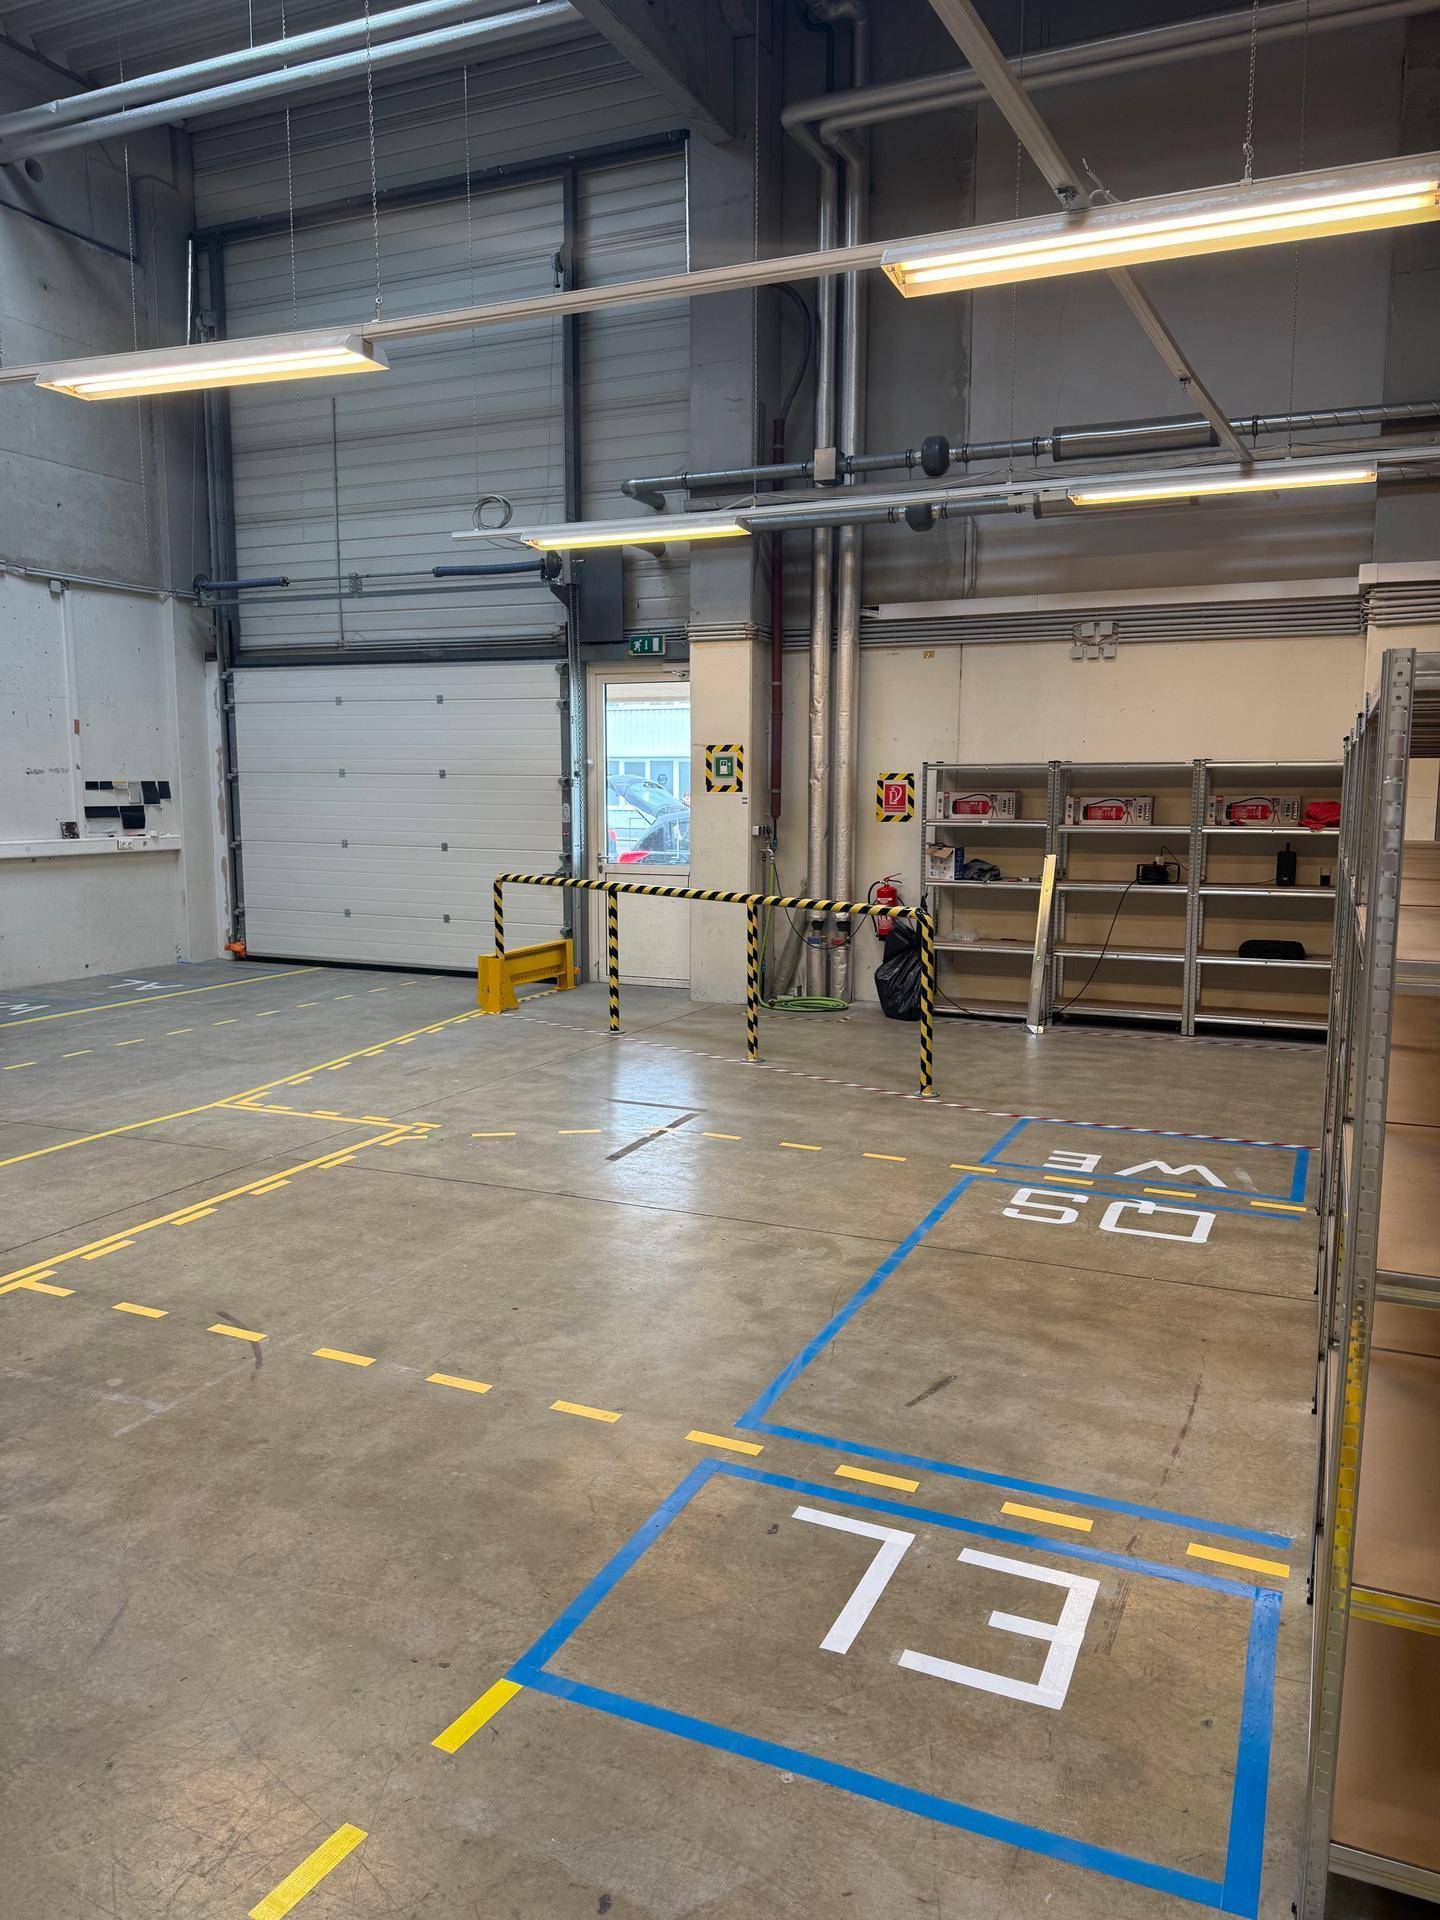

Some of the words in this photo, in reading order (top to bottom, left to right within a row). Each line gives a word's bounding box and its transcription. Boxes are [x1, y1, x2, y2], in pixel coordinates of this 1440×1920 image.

[1042, 1150, 1229, 1188] WE
[1001, 1187, 1216, 1244] QS
[791, 1505, 1101, 1711] EL
